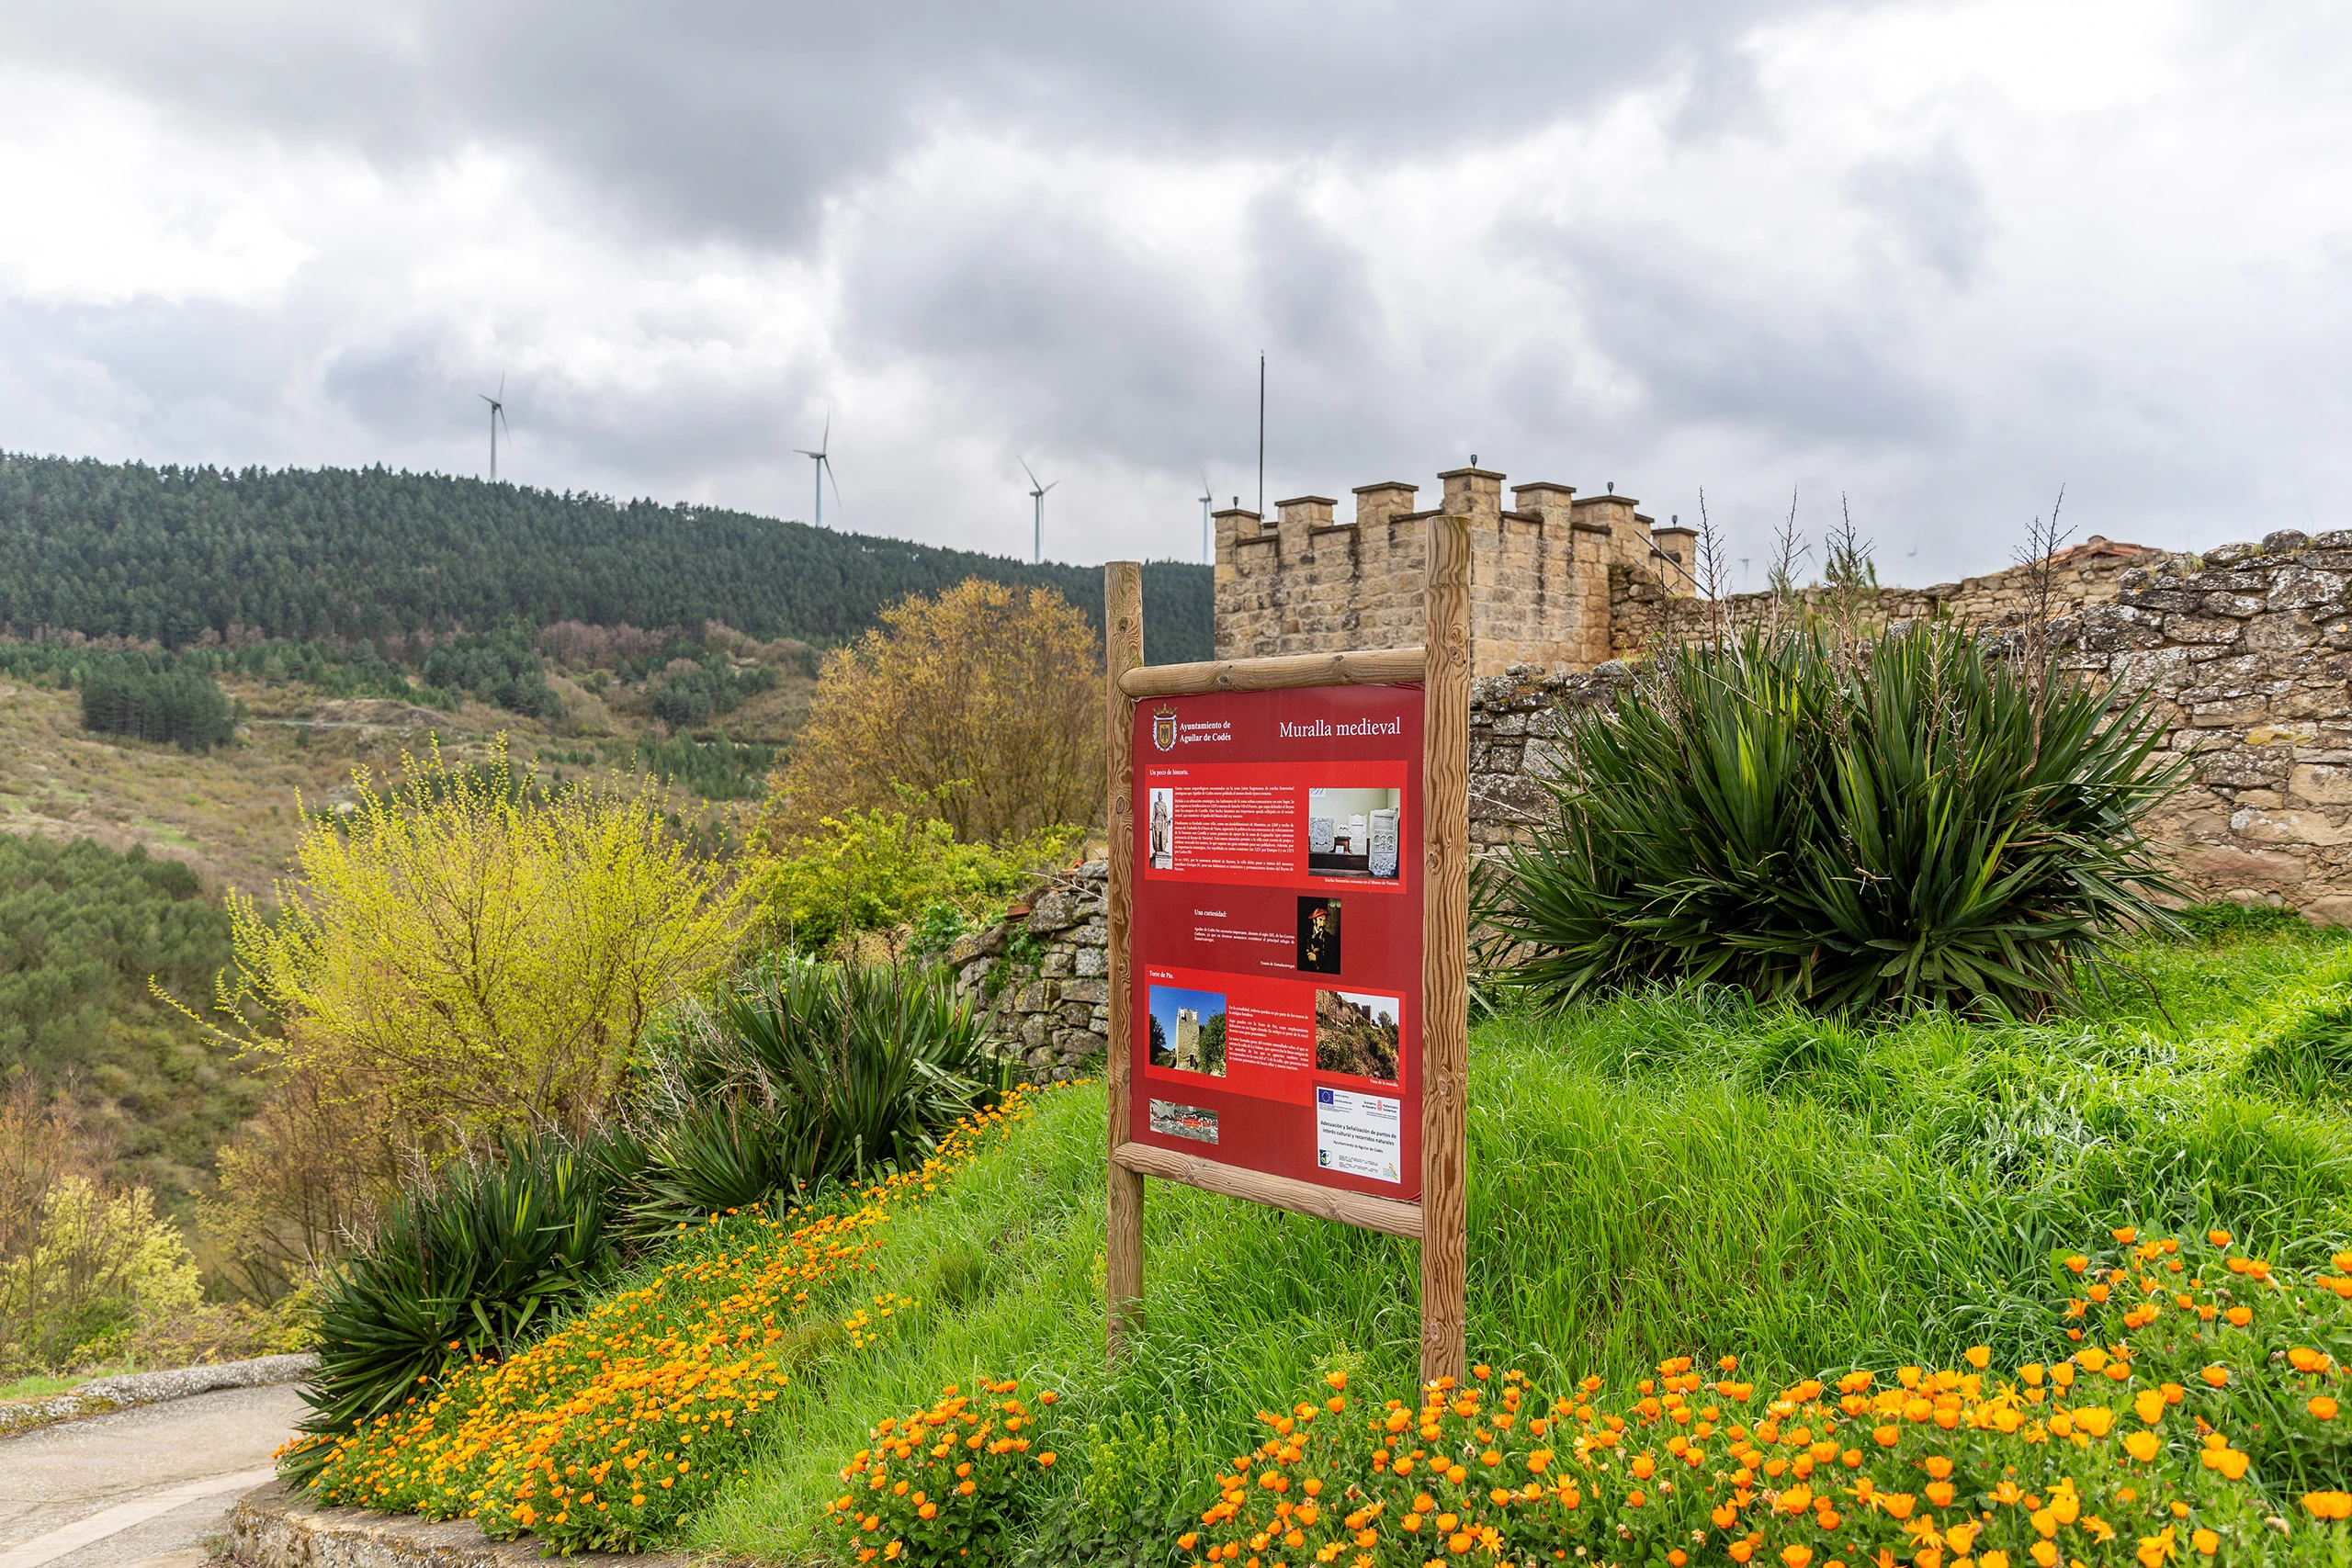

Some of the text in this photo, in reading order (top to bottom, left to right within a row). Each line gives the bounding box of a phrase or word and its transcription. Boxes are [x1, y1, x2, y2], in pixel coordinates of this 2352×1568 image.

[1180, 721, 1221, 732] Ayuntamiento
[1279, 716, 1401, 737] Muralla medieval
[1180, 733, 1202, 744] Aguilar
[1212, 733, 1231, 741] Codés
[1346, 1125, 1370, 1134] Señalización
